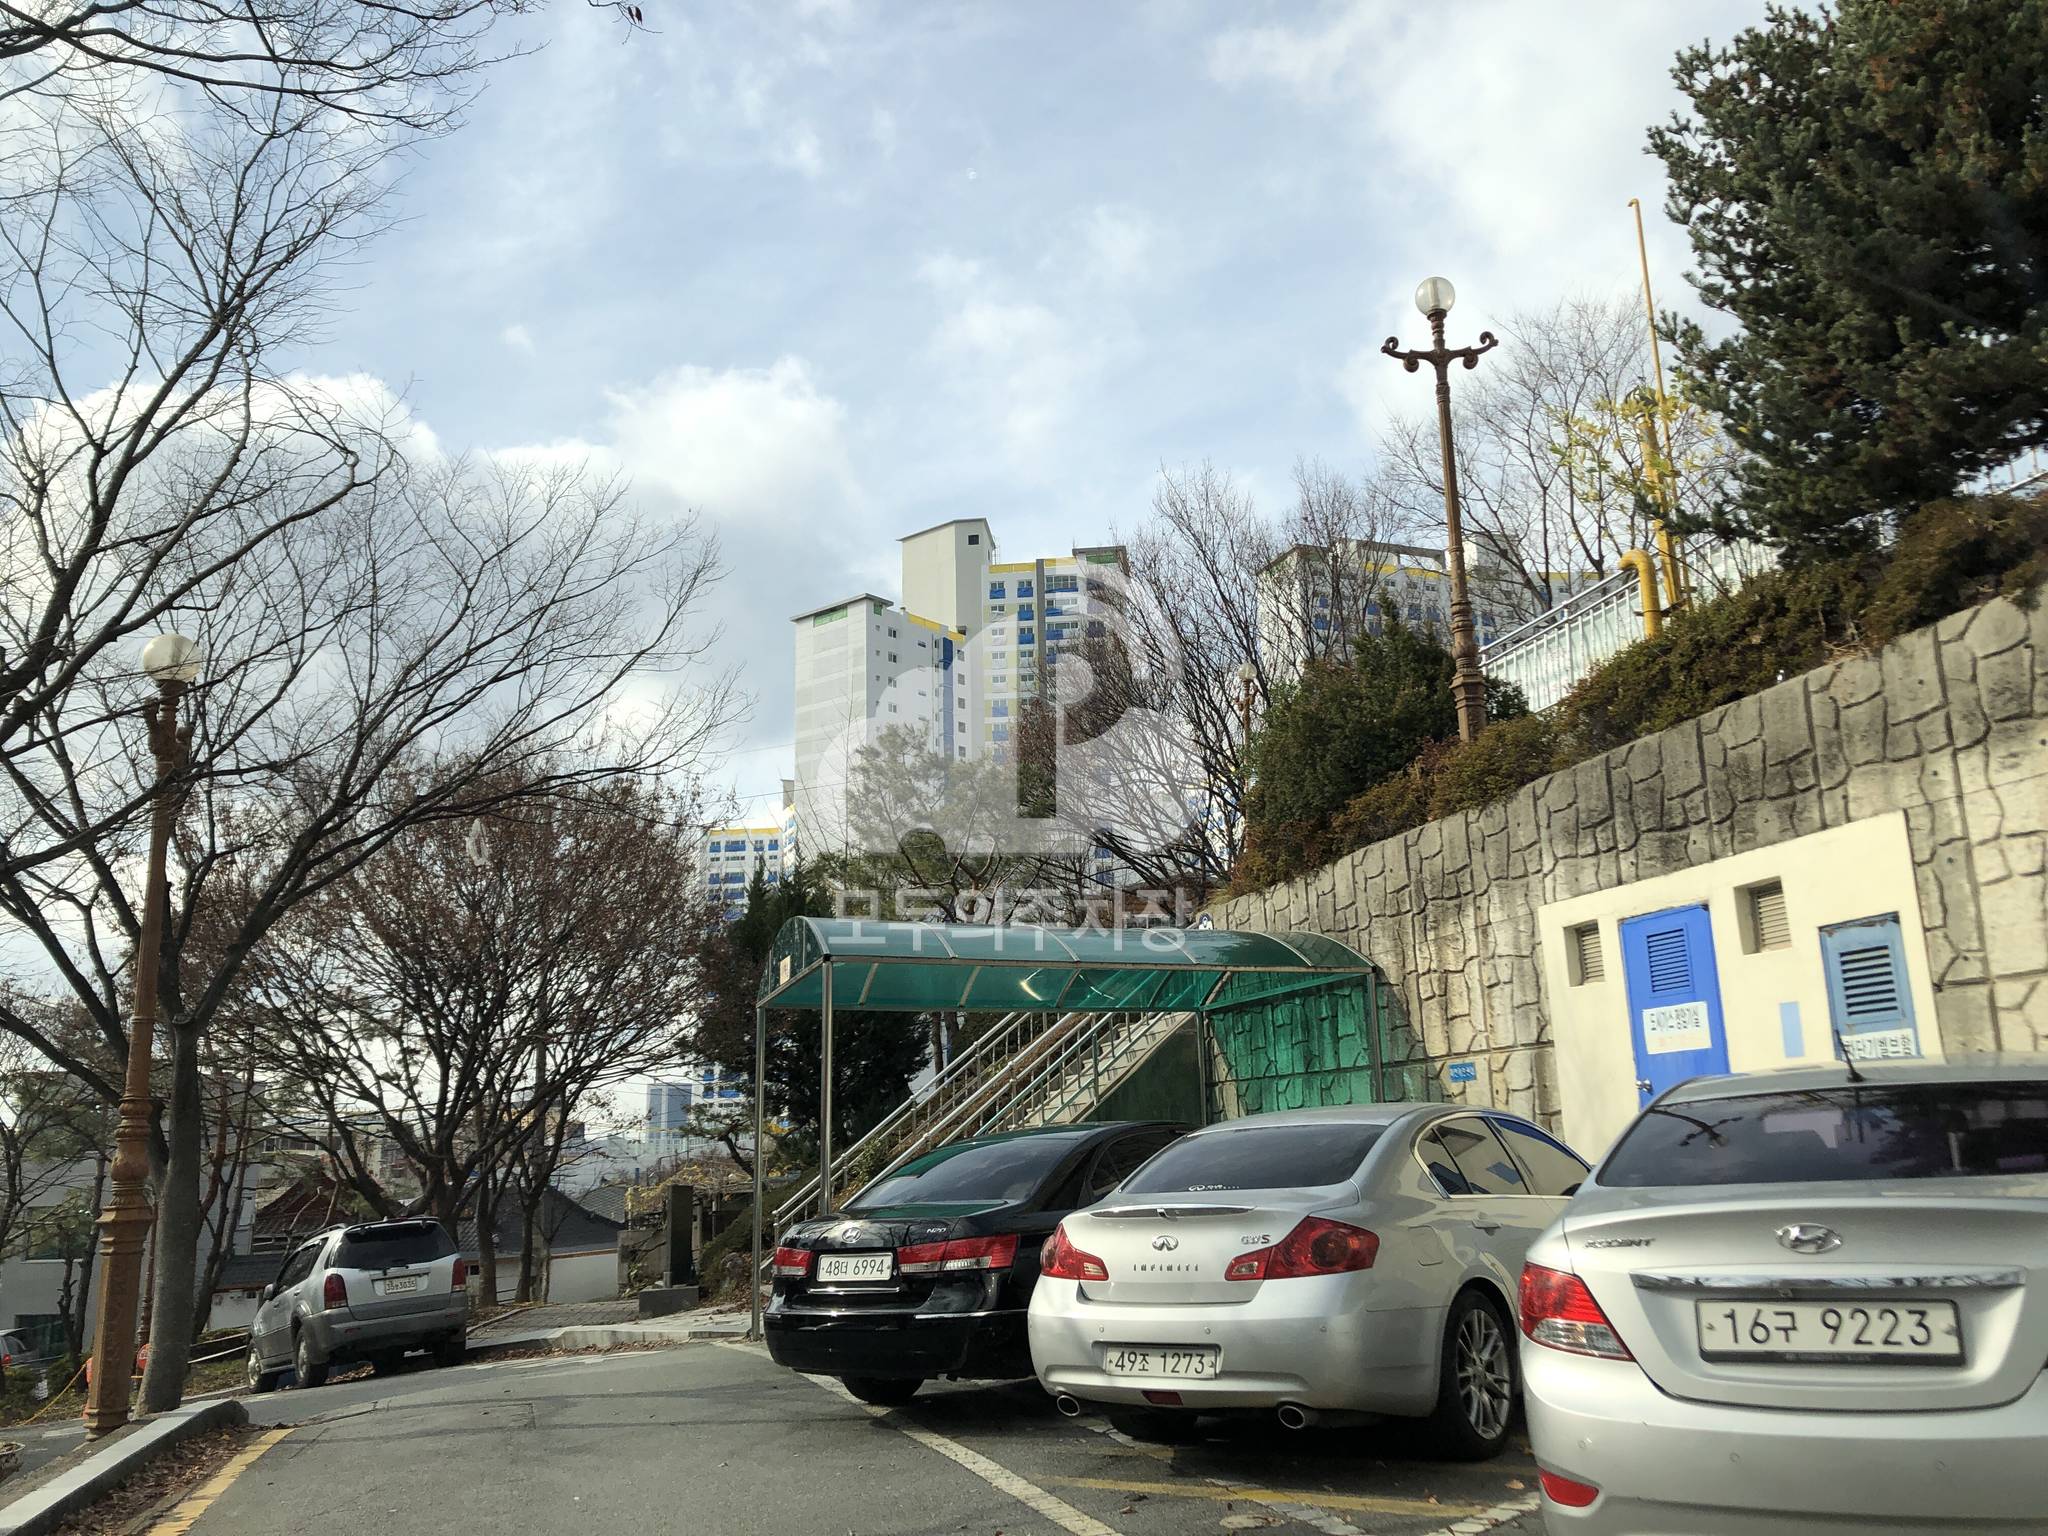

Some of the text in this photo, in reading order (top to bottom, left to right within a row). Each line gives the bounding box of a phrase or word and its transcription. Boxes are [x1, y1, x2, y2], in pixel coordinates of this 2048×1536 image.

[825, 1259, 884, 1276] 48더 6994
[1723, 1307, 1932, 1346] 16구 9223
[1115, 1350, 1206, 1374] 49조 1273
